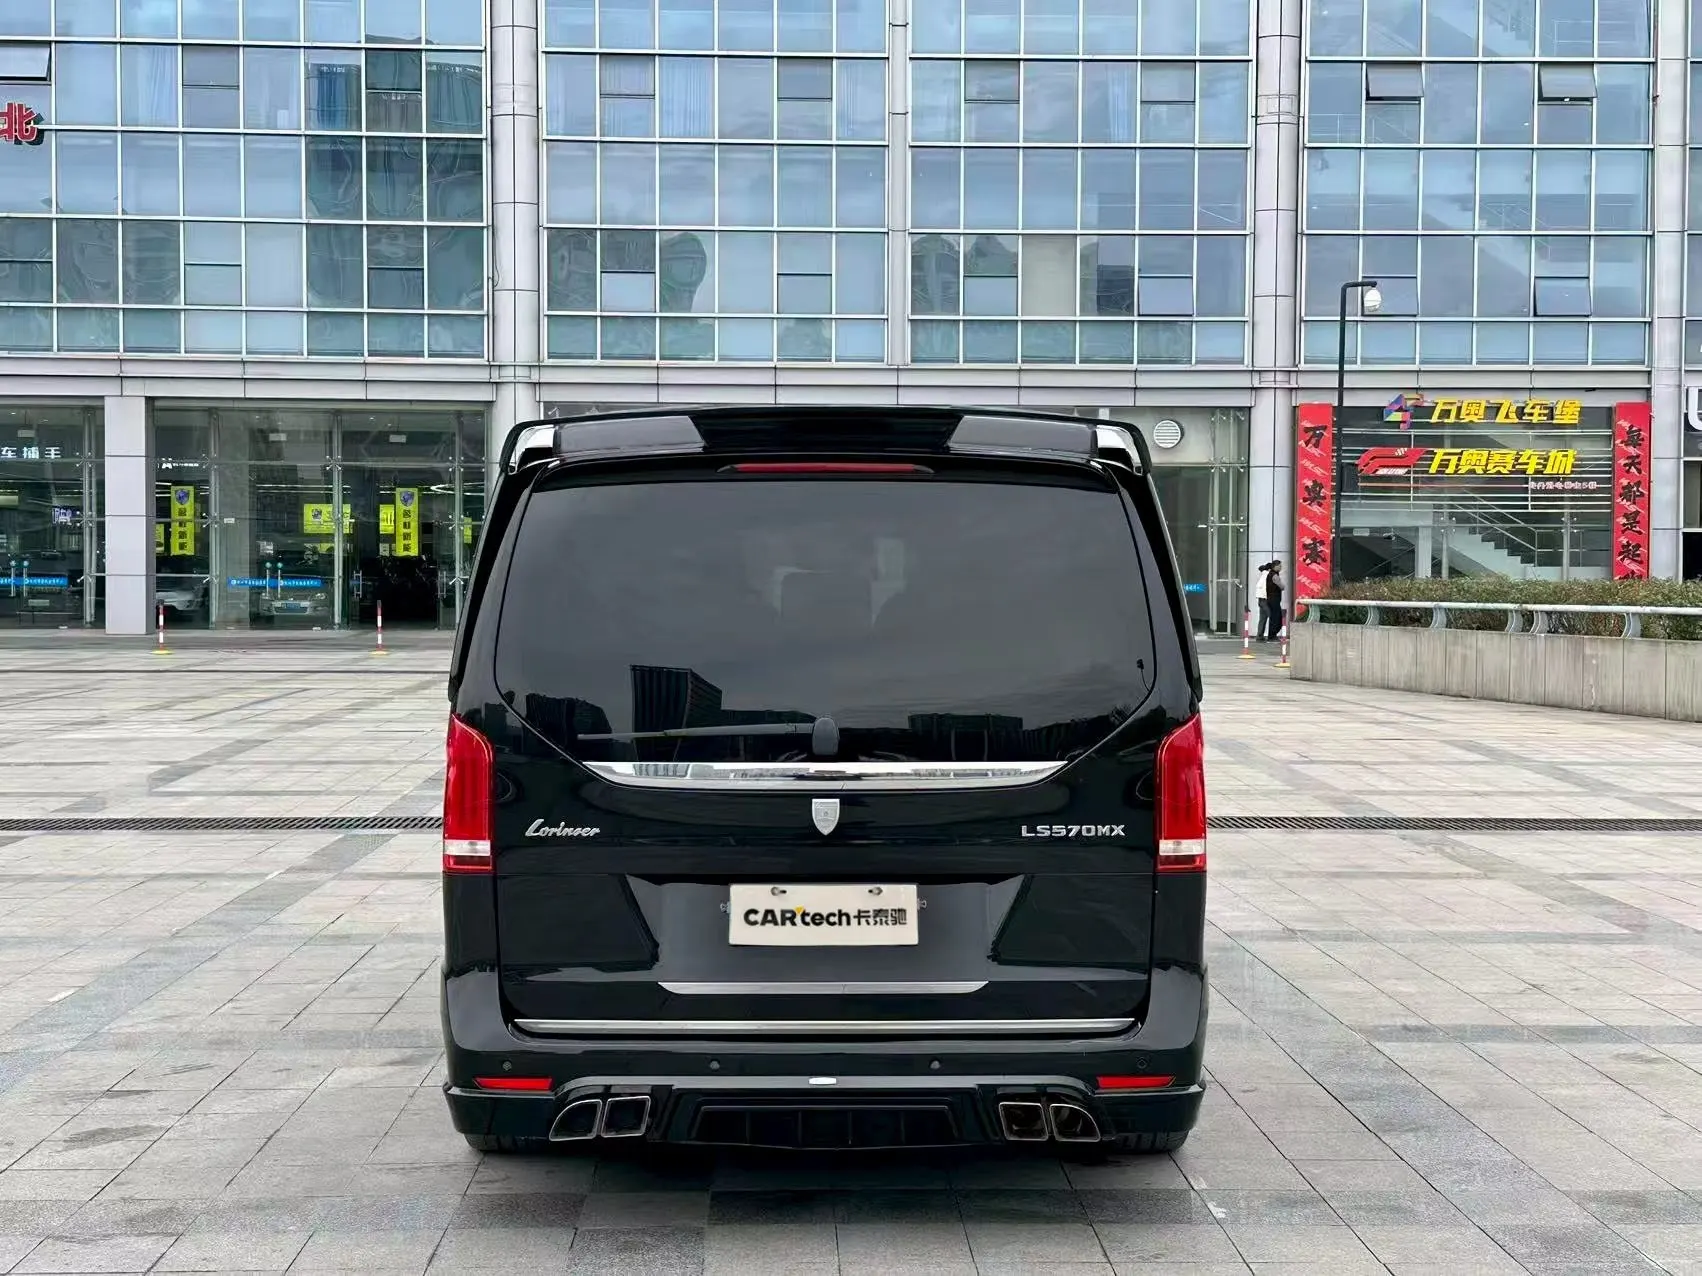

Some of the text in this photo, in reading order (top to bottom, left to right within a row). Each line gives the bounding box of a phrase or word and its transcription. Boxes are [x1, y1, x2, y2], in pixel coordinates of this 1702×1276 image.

[0, 102, 37, 142] 北
[1431, 399, 1582, 424] 万奥飞车堡
[1428, 449, 1578, 475] 万奥赛车城
[525, 818, 601, 837] Lorinser
[1021, 825, 1126, 837] LS570MX
[743, 908, 908, 927] CARtech 卡泰驰
